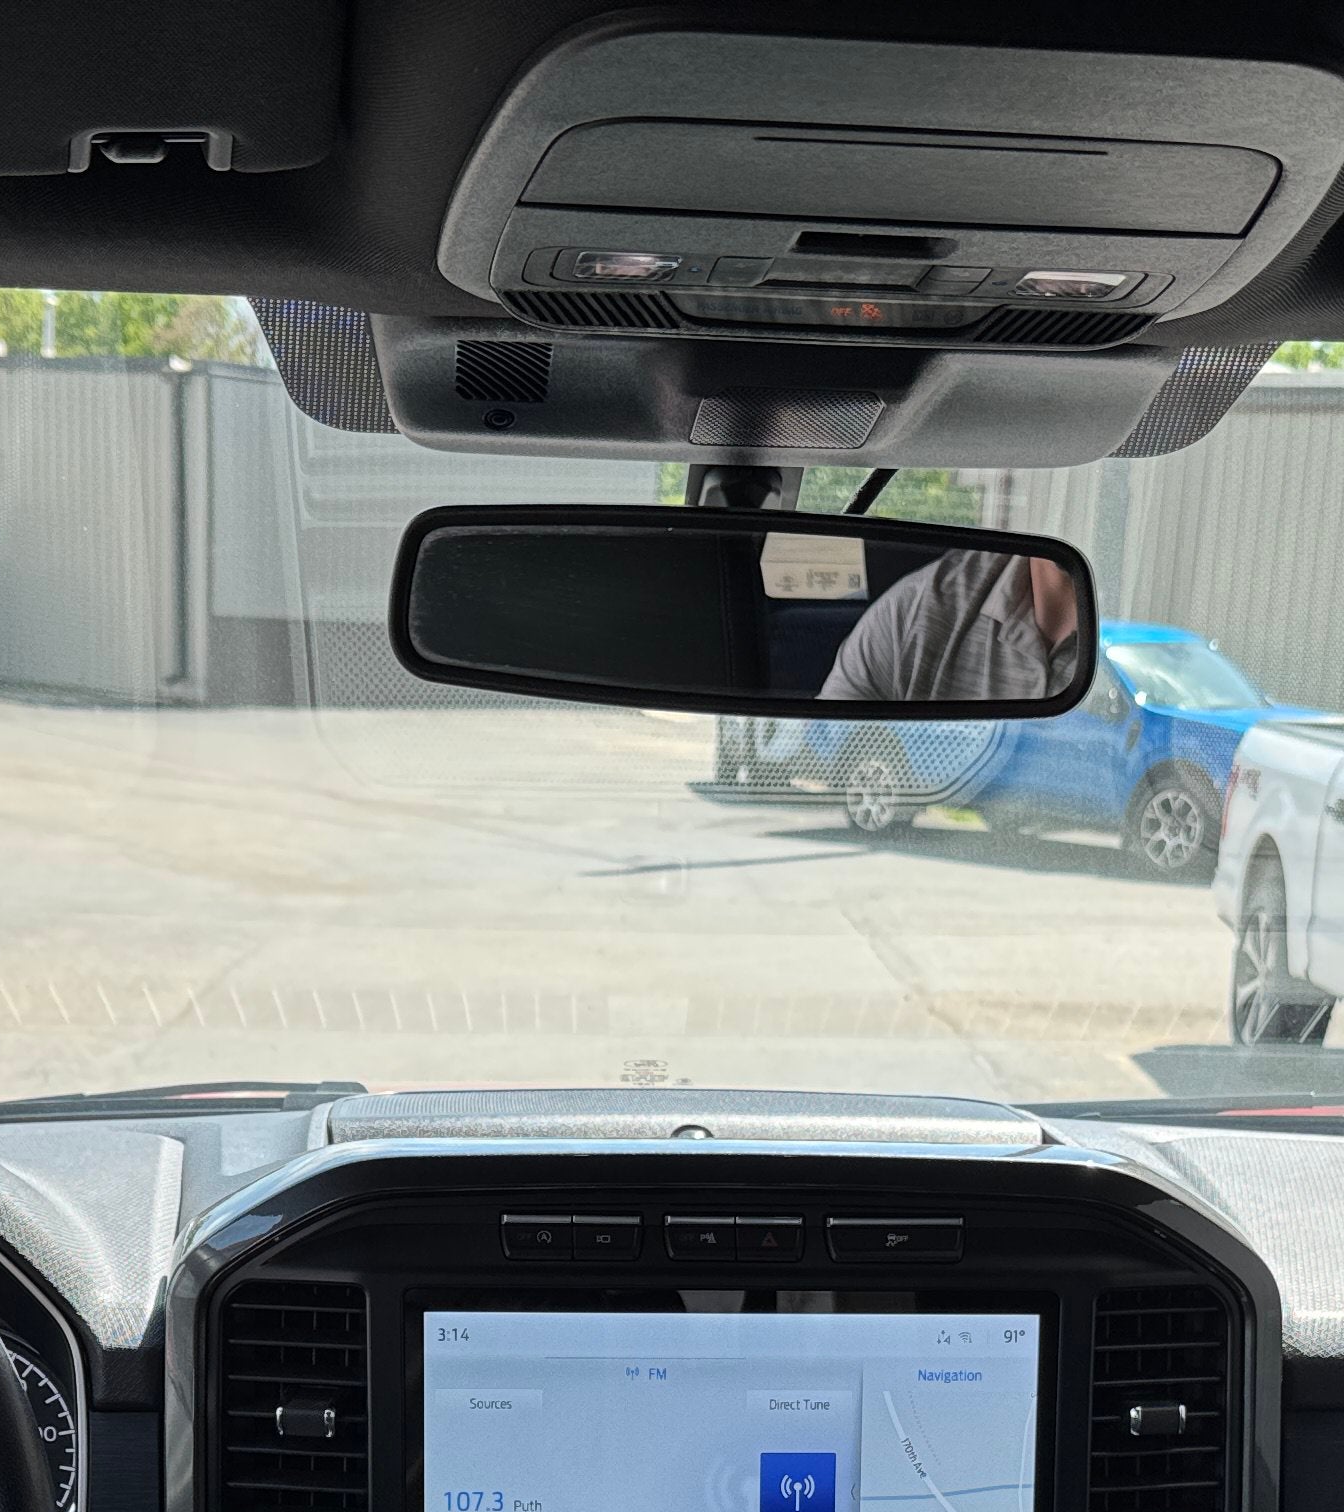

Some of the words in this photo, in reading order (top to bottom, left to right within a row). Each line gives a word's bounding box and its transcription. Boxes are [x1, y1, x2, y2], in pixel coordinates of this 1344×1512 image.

[437, 1327, 470, 1342] 3:14
[1003, 1329, 1026, 1344] 91°
[648, 1368, 667, 1380] FM
[917, 1369, 983, 1384] Navigation
[469, 1397, 513, 1410] Sources
[769, 1399, 801, 1411] Direct
[803, 1399, 831, 1411] Tune
[443, 1491, 504, 1512] 107.3
[513, 1499, 542, 1512] Puth
